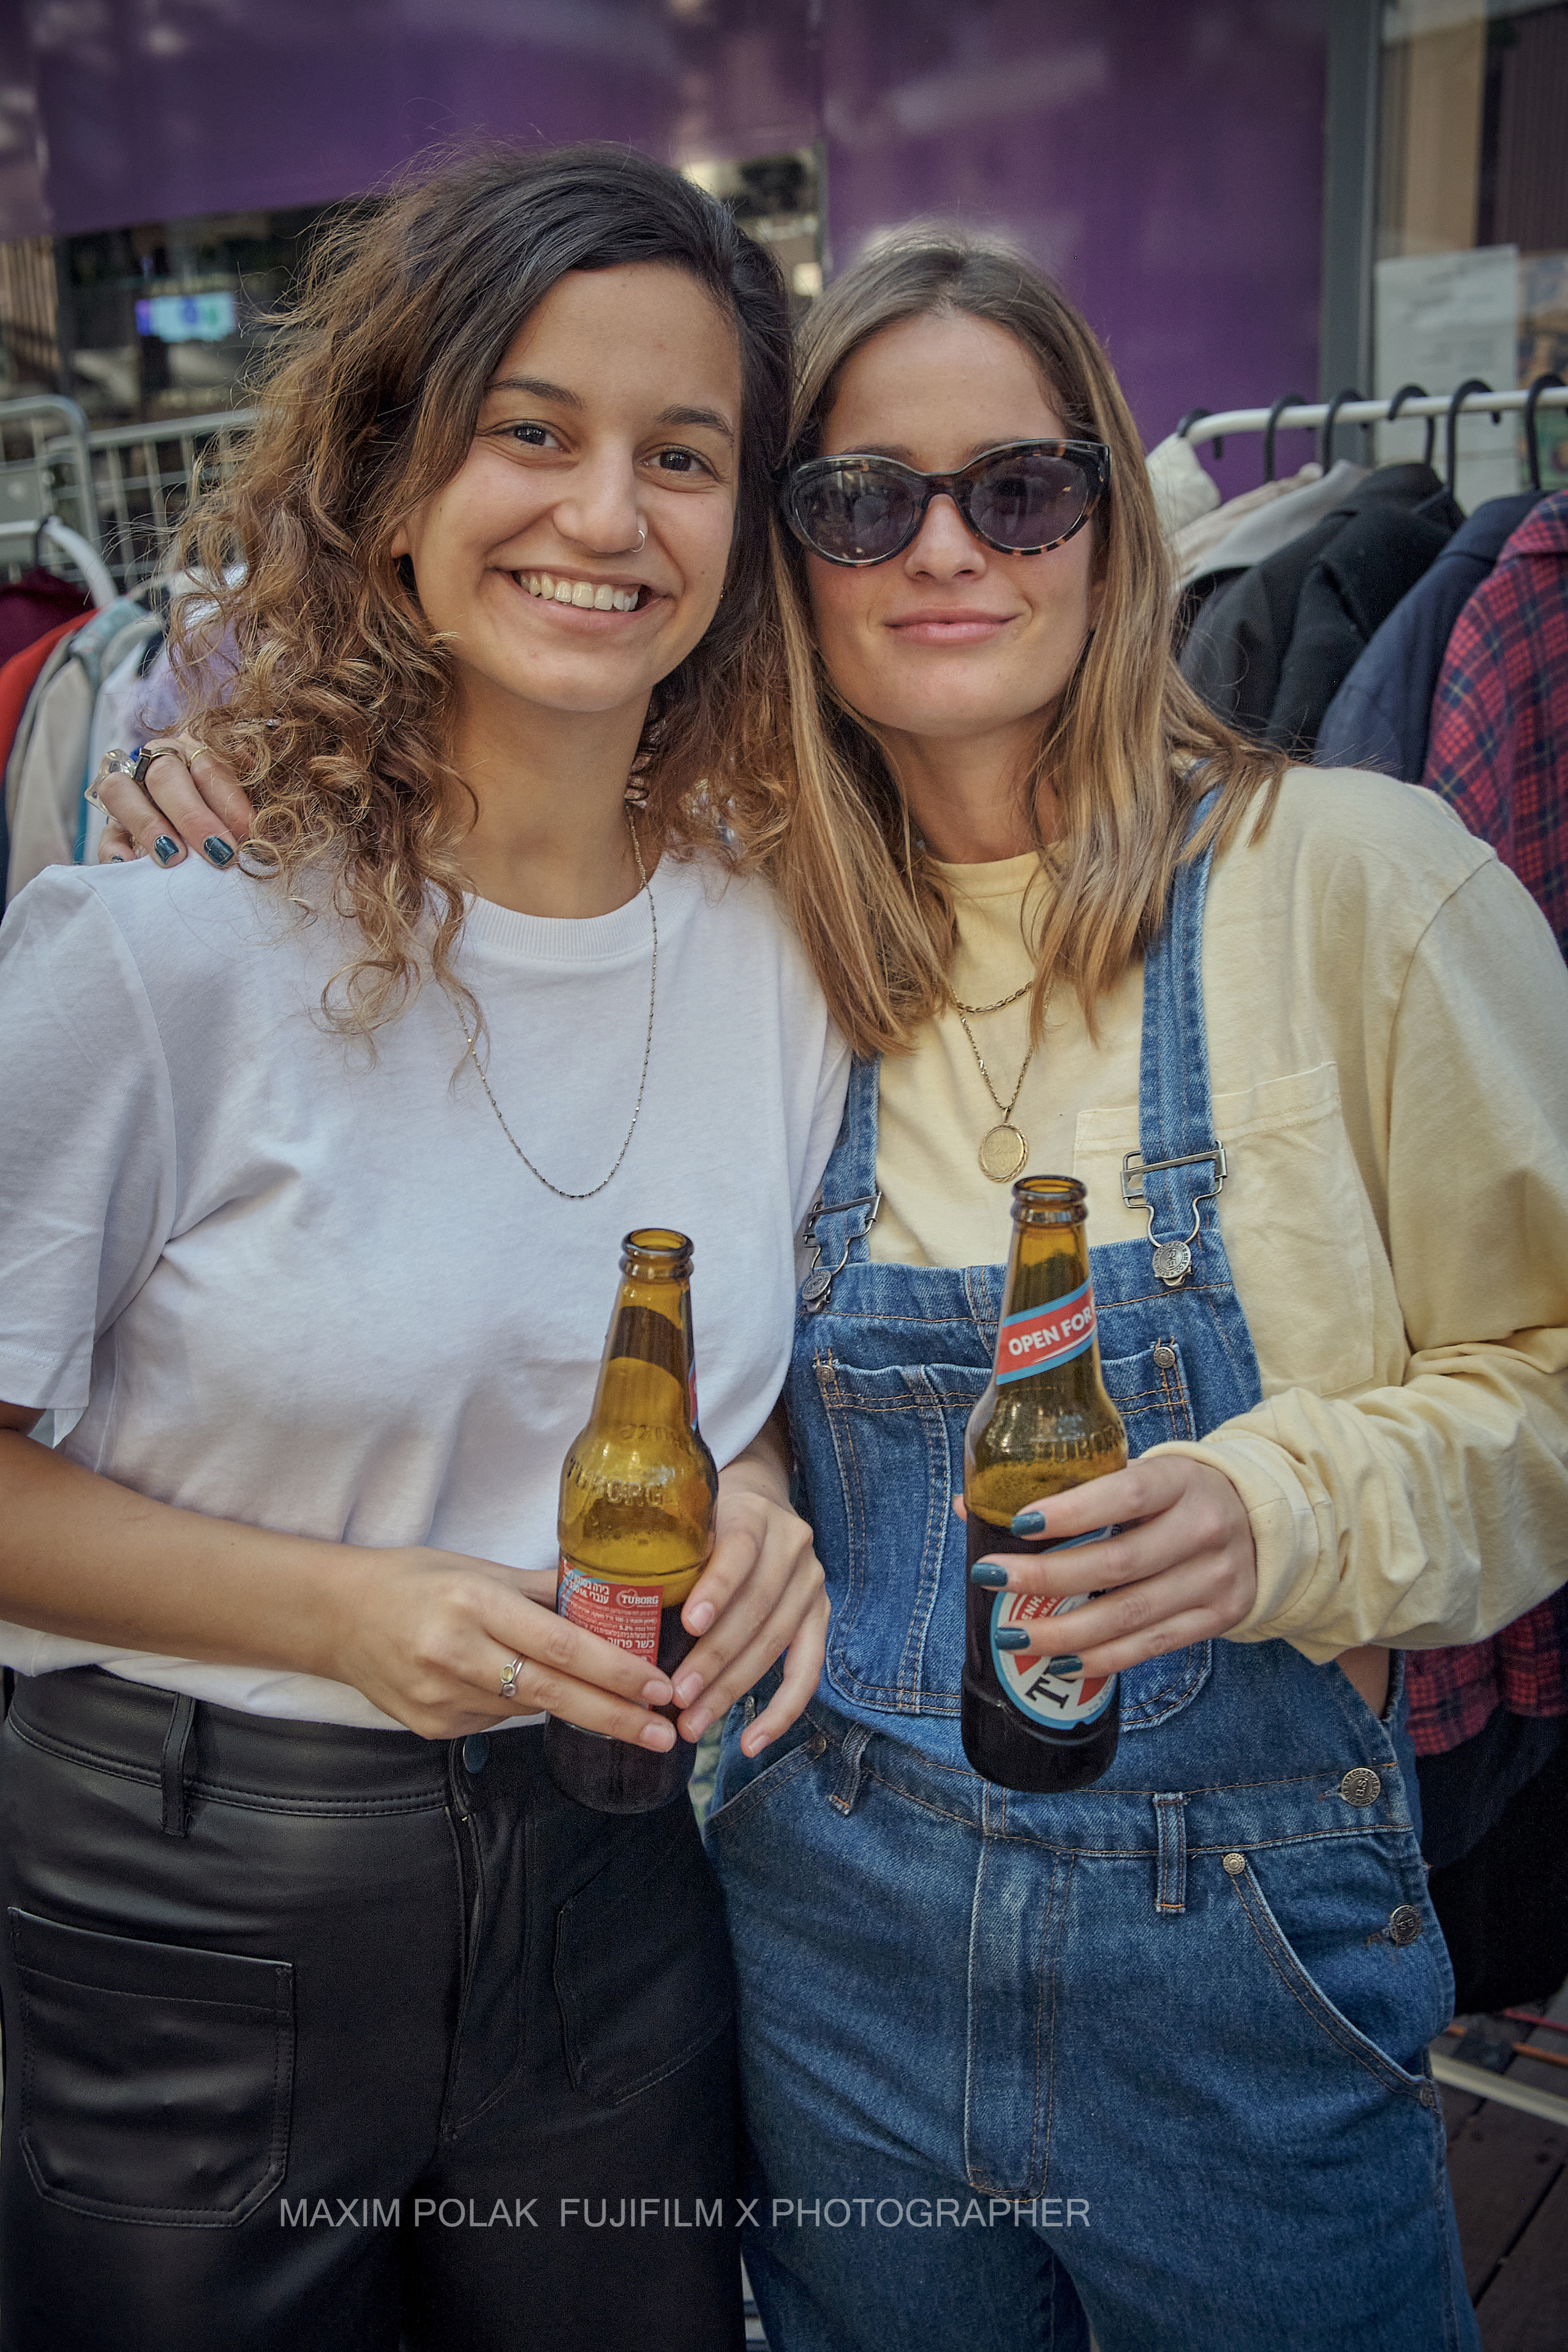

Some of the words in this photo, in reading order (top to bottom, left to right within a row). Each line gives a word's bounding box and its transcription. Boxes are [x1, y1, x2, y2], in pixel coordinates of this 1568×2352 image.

[1008, 1325, 1061, 1356] OPEN
[1060, 1306, 1093, 1338] FOR
[592, 1583, 609, 1596] בירה
[589, 1591, 609, 1605] ענברי
[622, 1594, 659, 1605] TUBORG
[635, 1638, 655, 1649] כשר
